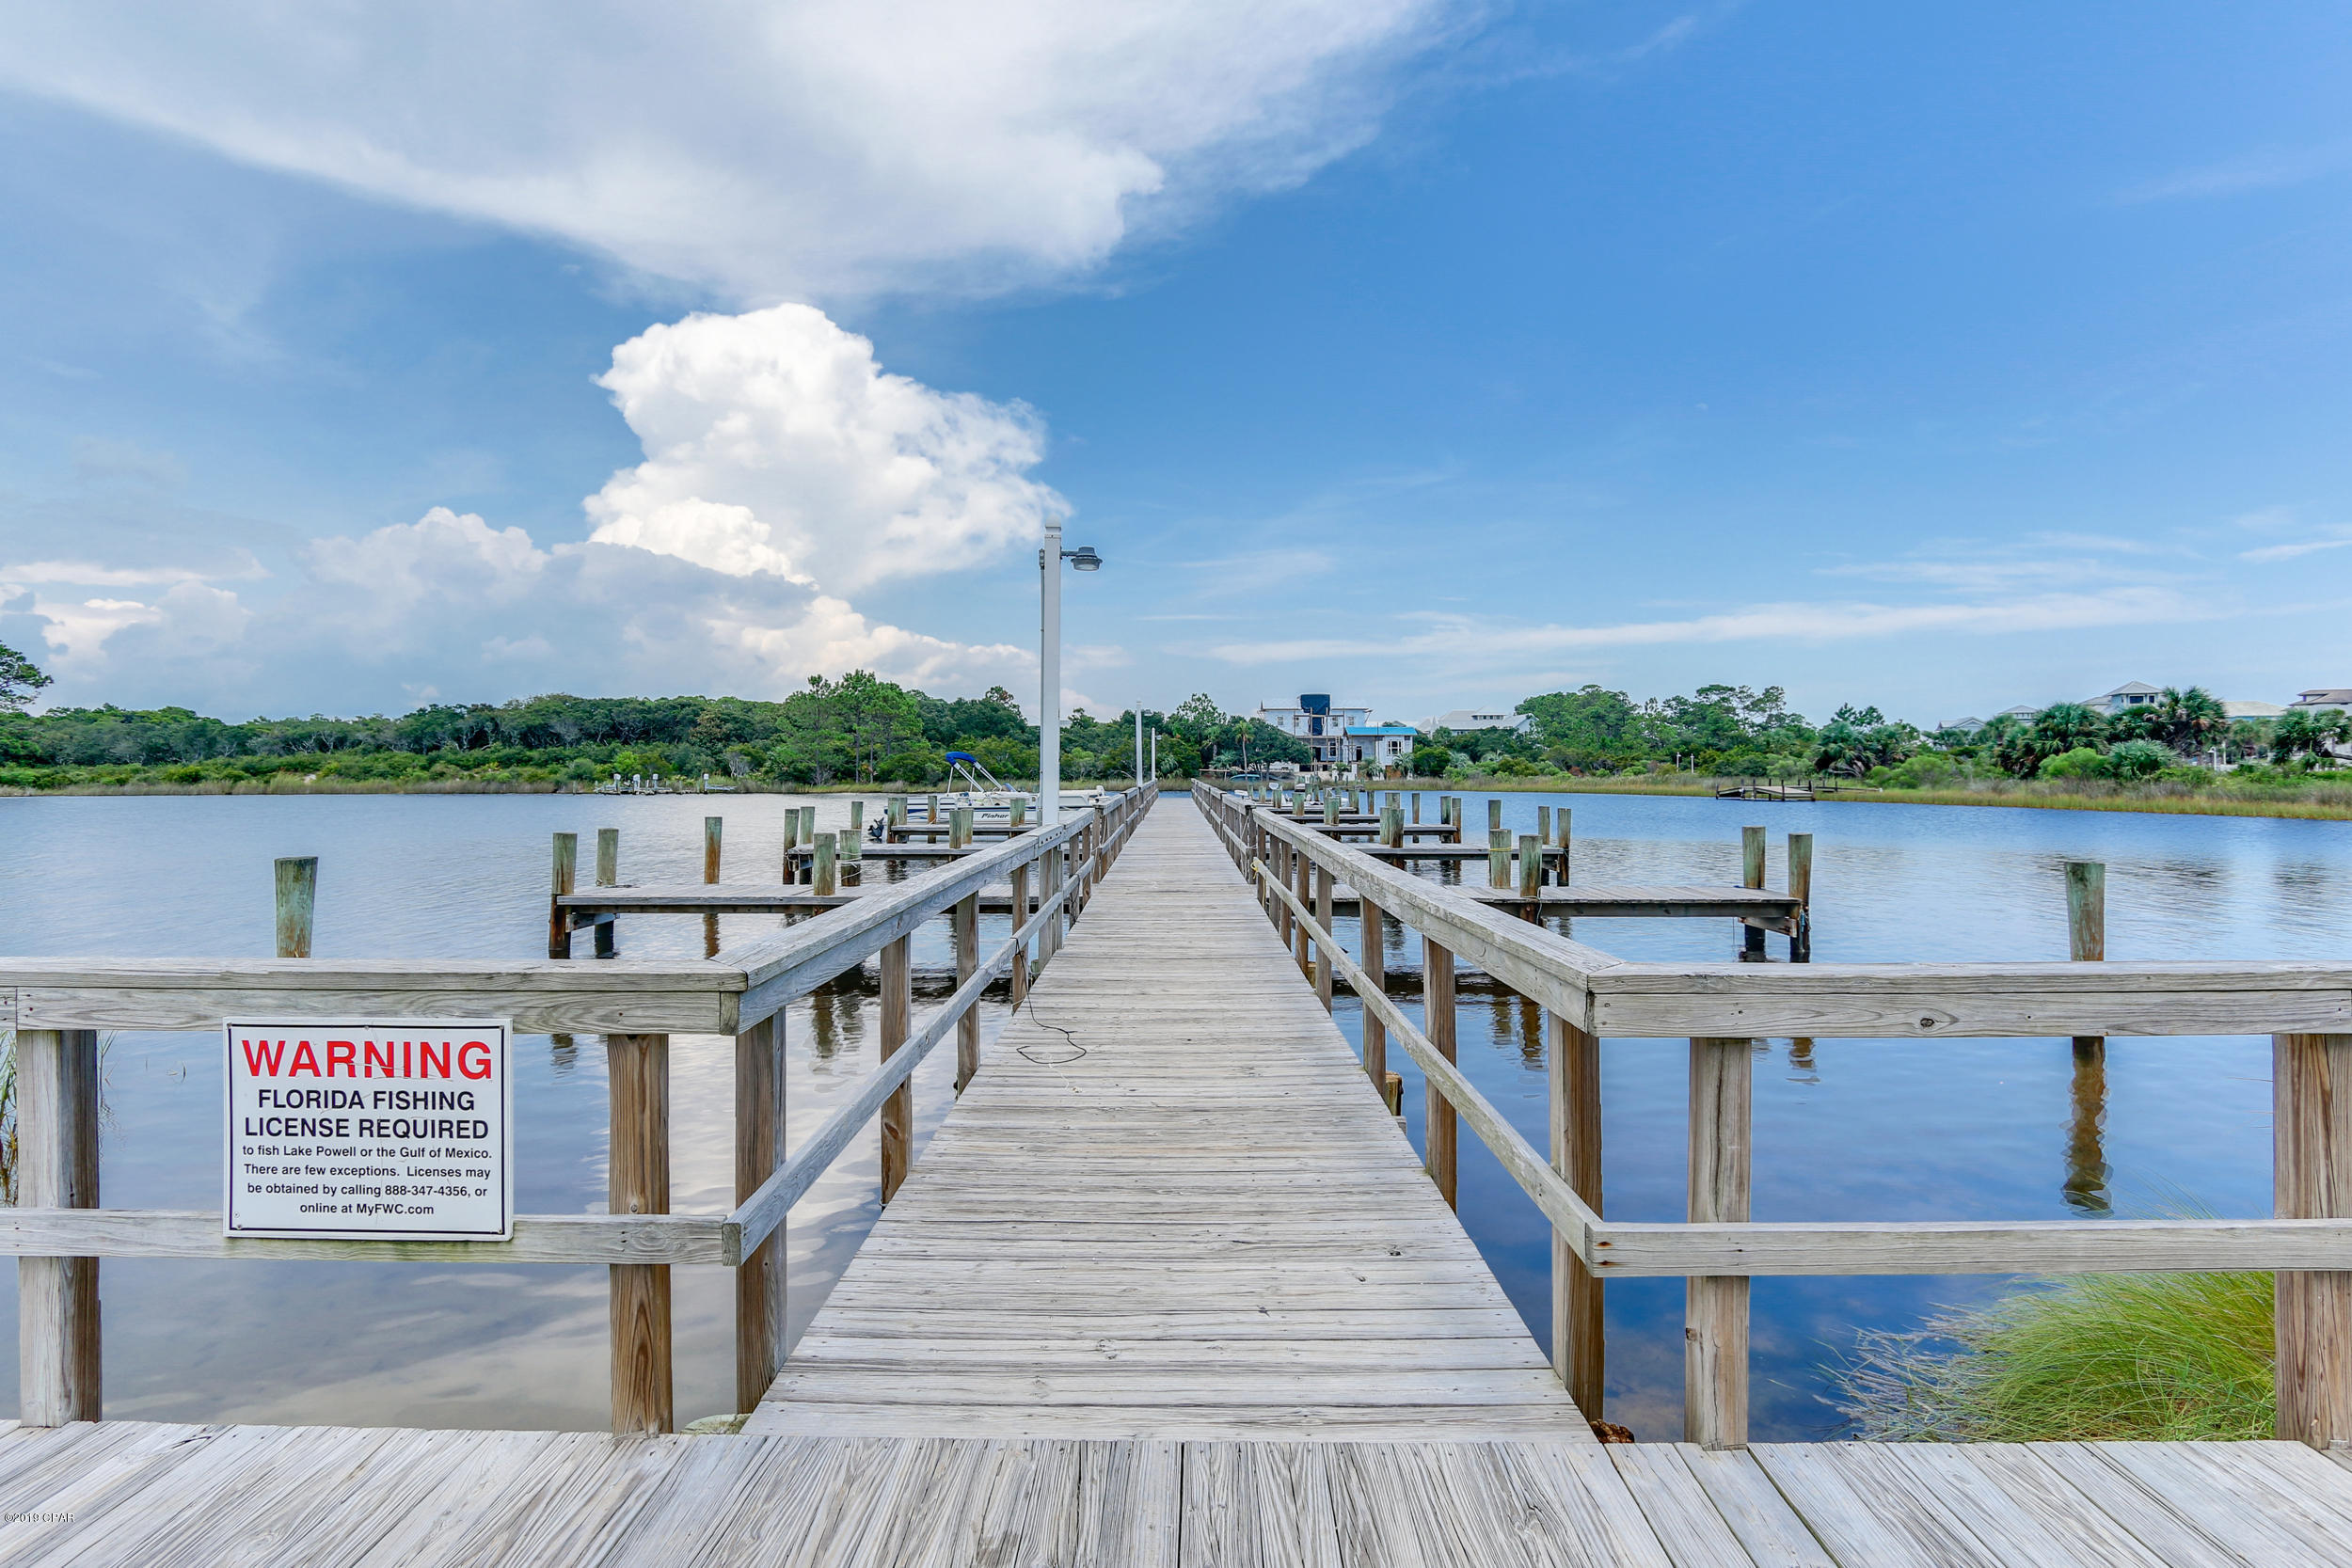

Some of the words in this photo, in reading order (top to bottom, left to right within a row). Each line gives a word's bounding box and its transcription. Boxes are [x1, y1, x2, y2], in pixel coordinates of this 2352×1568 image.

[242, 1040, 492, 1079] WARNING
[259, 1089, 364, 1109] FLORIDA
[373, 1090, 474, 1110] FISHING
[245, 1117, 349, 1136] LICENSE
[358, 1119, 488, 1139] REQUIRED
[243, 1146, 254, 1156] to
[258, 1146, 279, 1156] fish
[284, 1146, 312, 1156] Lake
[317, 1147, 356, 1157] Powell
[376, 1147, 395, 1157] the
[400, 1148, 425, 1158] Gulf
[429, 1148, 441, 1158] of
[446, 1148, 492, 1158] Mexico.
[245, 1164, 278, 1175] There
[305, 1164, 326, 1175] few
[330, 1165, 400, 1178] exceptions.
[407, 1166, 461, 1177] Licenses
[466, 1169, 490, 1180] may
[248, 1183, 262, 1194] be
[266, 1184, 318, 1194] obtained
[323, 1184, 337, 1196] by
[342, 1185, 381, 1196] calling
[385, 1186, 470, 1197] 888-347-4356,
[474, 1188, 486, 1196] or
[300, 1203, 337, 1213] online
[342, 1204, 352, 1213] at
[357, 1204, 434, 1216] MyFWC.com
